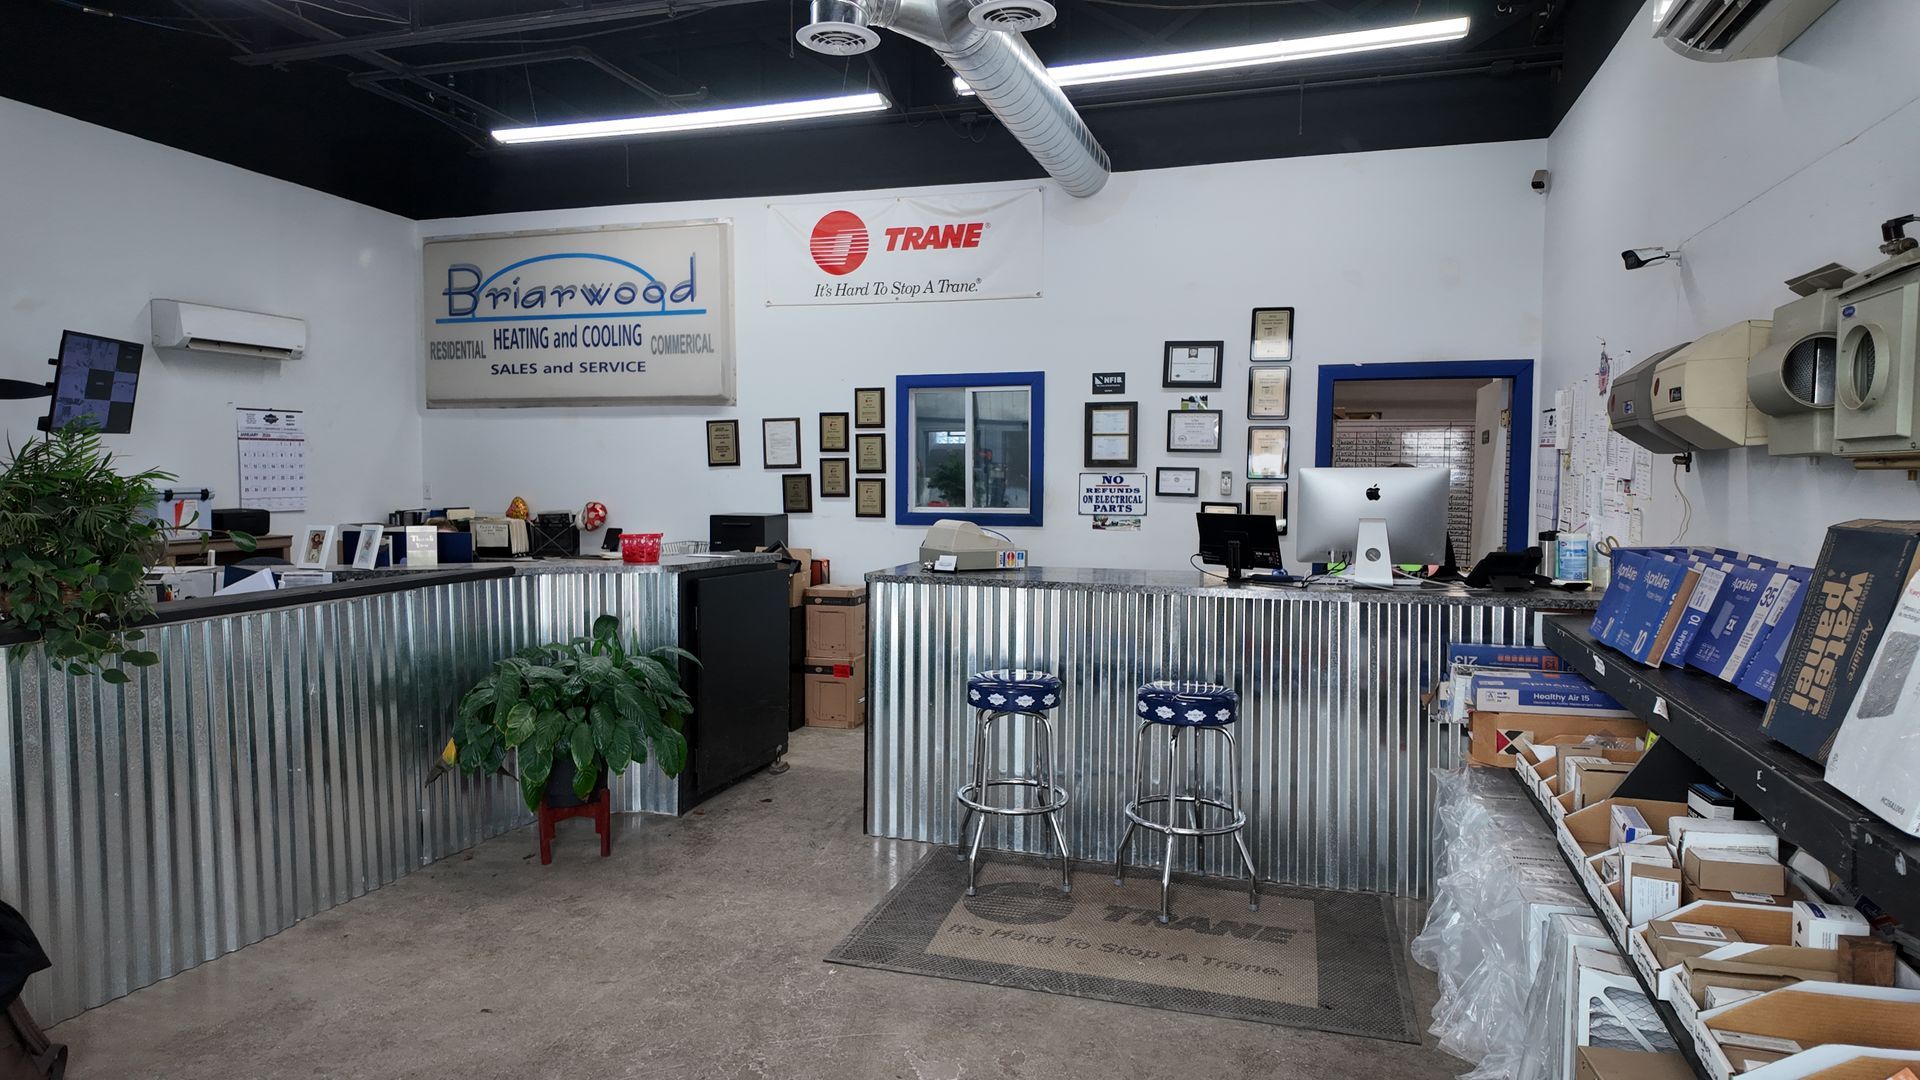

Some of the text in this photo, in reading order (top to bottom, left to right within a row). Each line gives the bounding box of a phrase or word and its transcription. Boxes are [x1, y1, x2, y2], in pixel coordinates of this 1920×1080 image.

[885, 222, 984, 251] TRANE
[442, 252, 696, 316] Briarwood
[814, 279, 979, 297] It's Hard To Stop A Trane.
[493, 323, 642, 350] HEATING and COOLING
[650, 333, 714, 355] COMMERICAL
[430, 340, 486, 360] RESIDENTIAL
[491, 360, 647, 375] SALES and SERVICE
[1101, 475, 1124, 485] NO
[1082, 495, 1143, 504] ON ELECTRICAL
[1093, 504, 1133, 513] PARTS
[1759, 586, 1779, 608] 35
[1846, 573, 1875, 642] HUMIDIFIER
[1688, 614, 1701, 626] 10
[1631, 630, 1648, 655] 10
[1670, 630, 1689, 659] AprilAire
[1789, 580, 1847, 712] panel
[1812, 571, 1869, 715] water
[1847, 619, 1874, 681] Aprilaire
[1533, 693, 1566, 702] Healthy
[1101, 905, 1298, 944] TRANE
[948, 923, 982, 936] It's
[989, 928, 1056, 945] Hard
[1065, 936, 1091, 950] To
[1098, 942, 1161, 961] Stop
[1166, 953, 1189, 963] A
